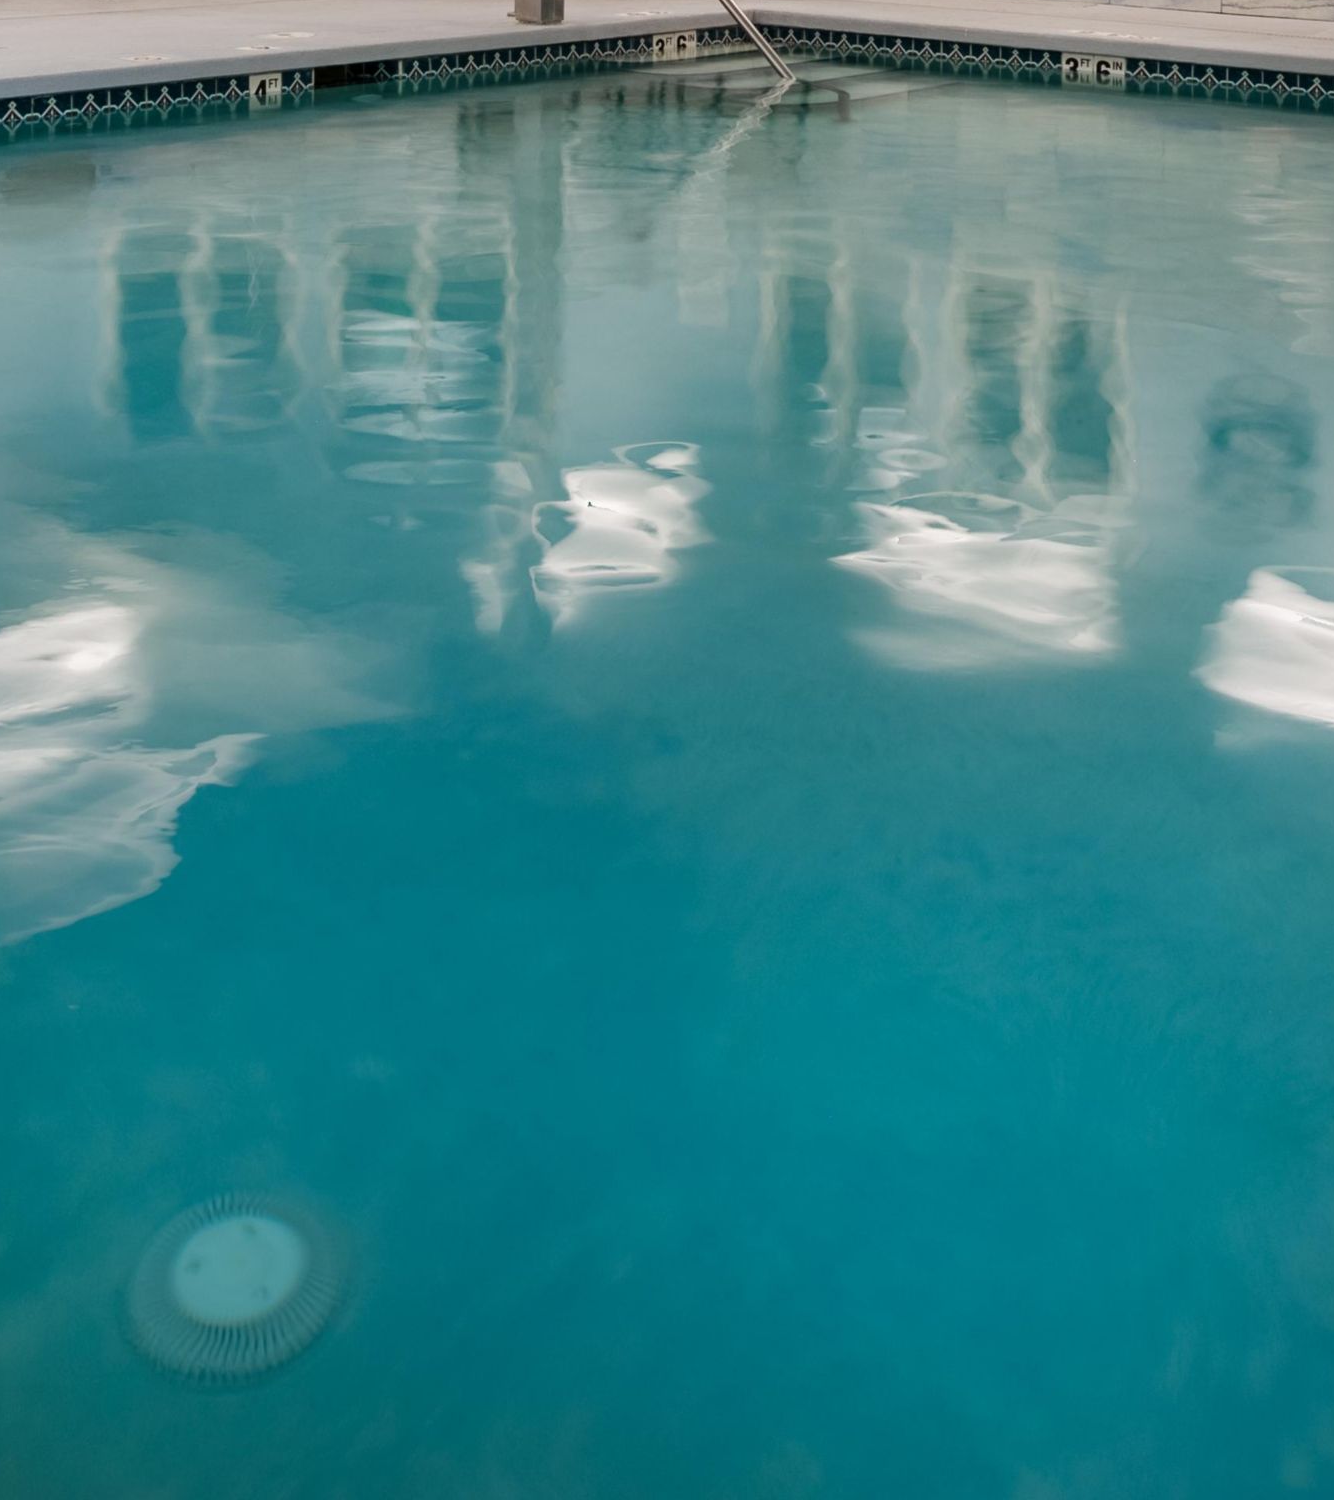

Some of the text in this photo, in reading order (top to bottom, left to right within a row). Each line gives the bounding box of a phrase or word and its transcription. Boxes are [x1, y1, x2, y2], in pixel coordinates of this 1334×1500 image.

[666, 37, 673, 46] FT
[688, 34, 695, 43] IN
[1080, 58, 1091, 68] FT
[1112, 60, 1123, 71] IN
[268, 78, 279, 89] FT
